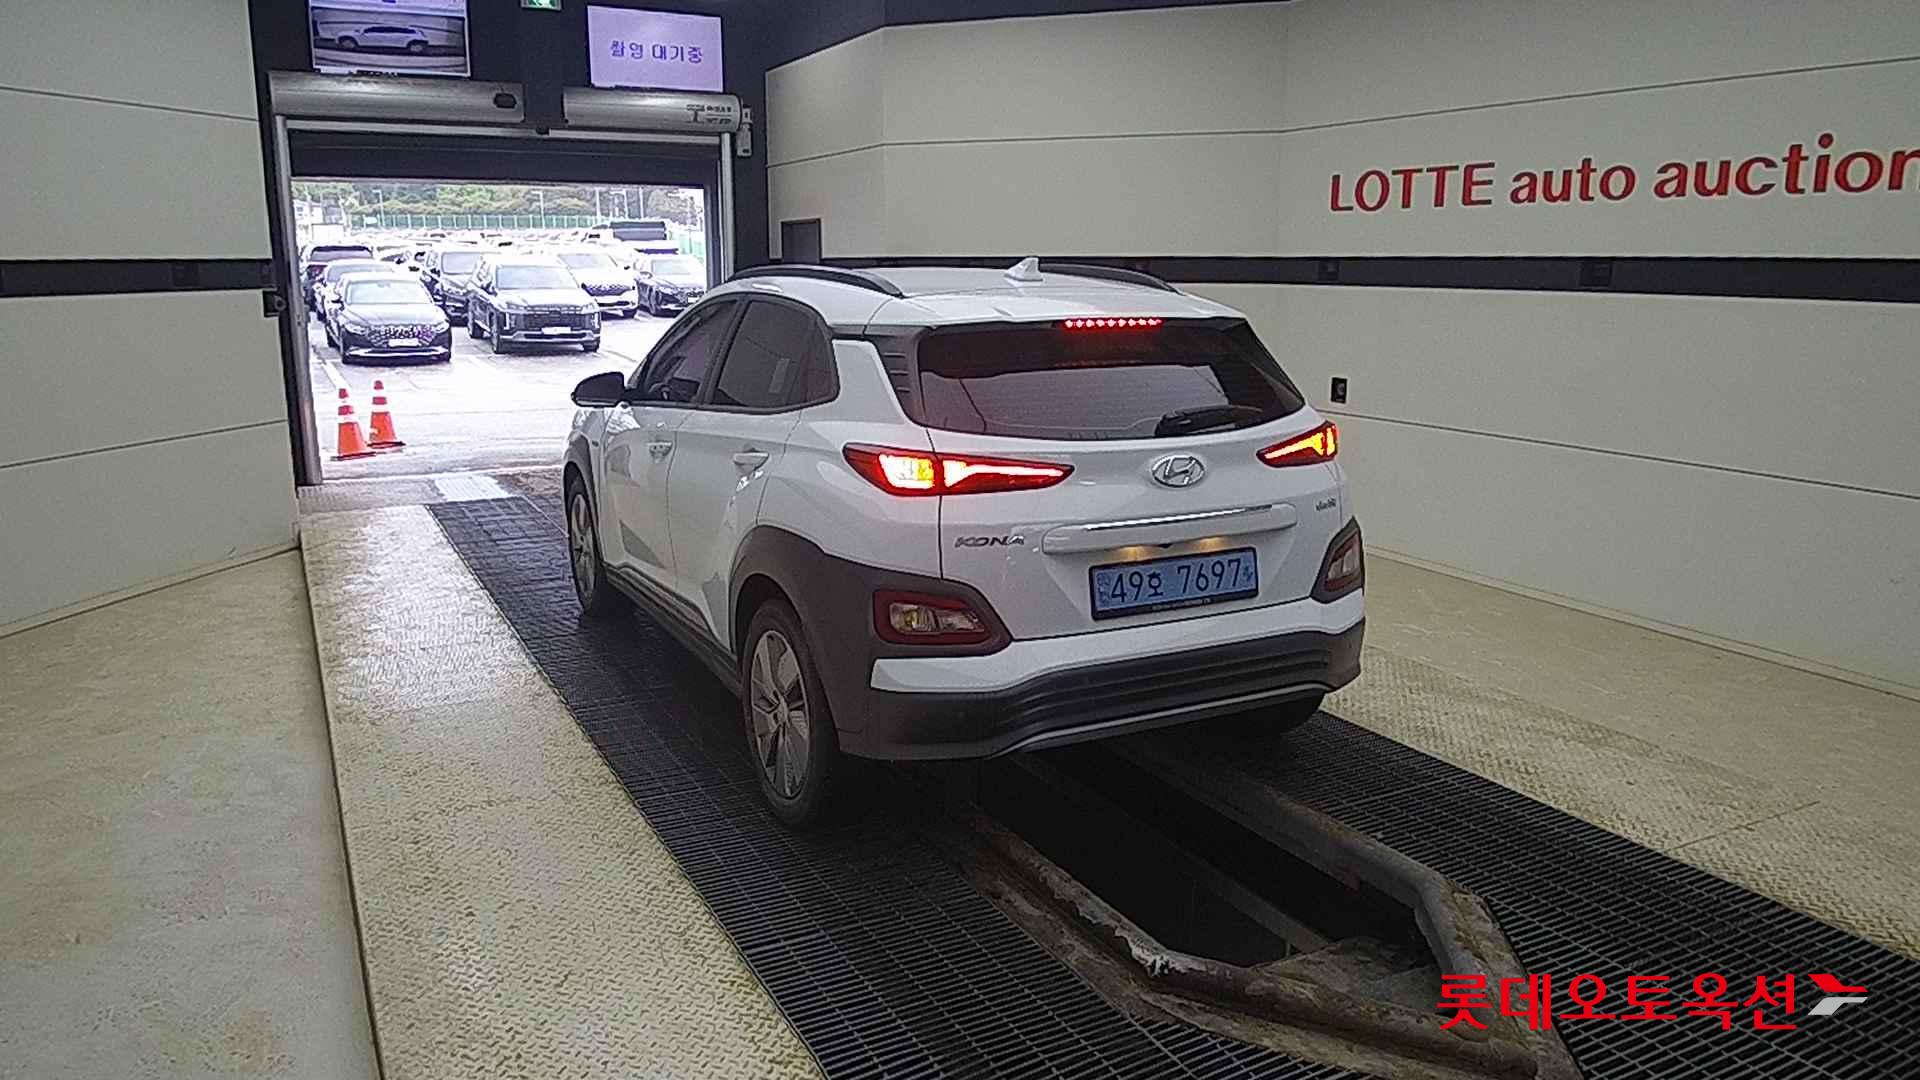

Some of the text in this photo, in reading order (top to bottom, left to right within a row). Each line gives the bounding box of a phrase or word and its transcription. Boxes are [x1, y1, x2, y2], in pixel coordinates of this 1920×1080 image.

[611, 40, 703, 64] 촬영 대기중
[1330, 161, 1496, 212] LOTTE
[1510, 157, 1636, 204] auto
[954, 534, 1025, 548] KONA
[1111, 570, 1164, 602] 49호
[1177, 558, 1241, 594] 7697
